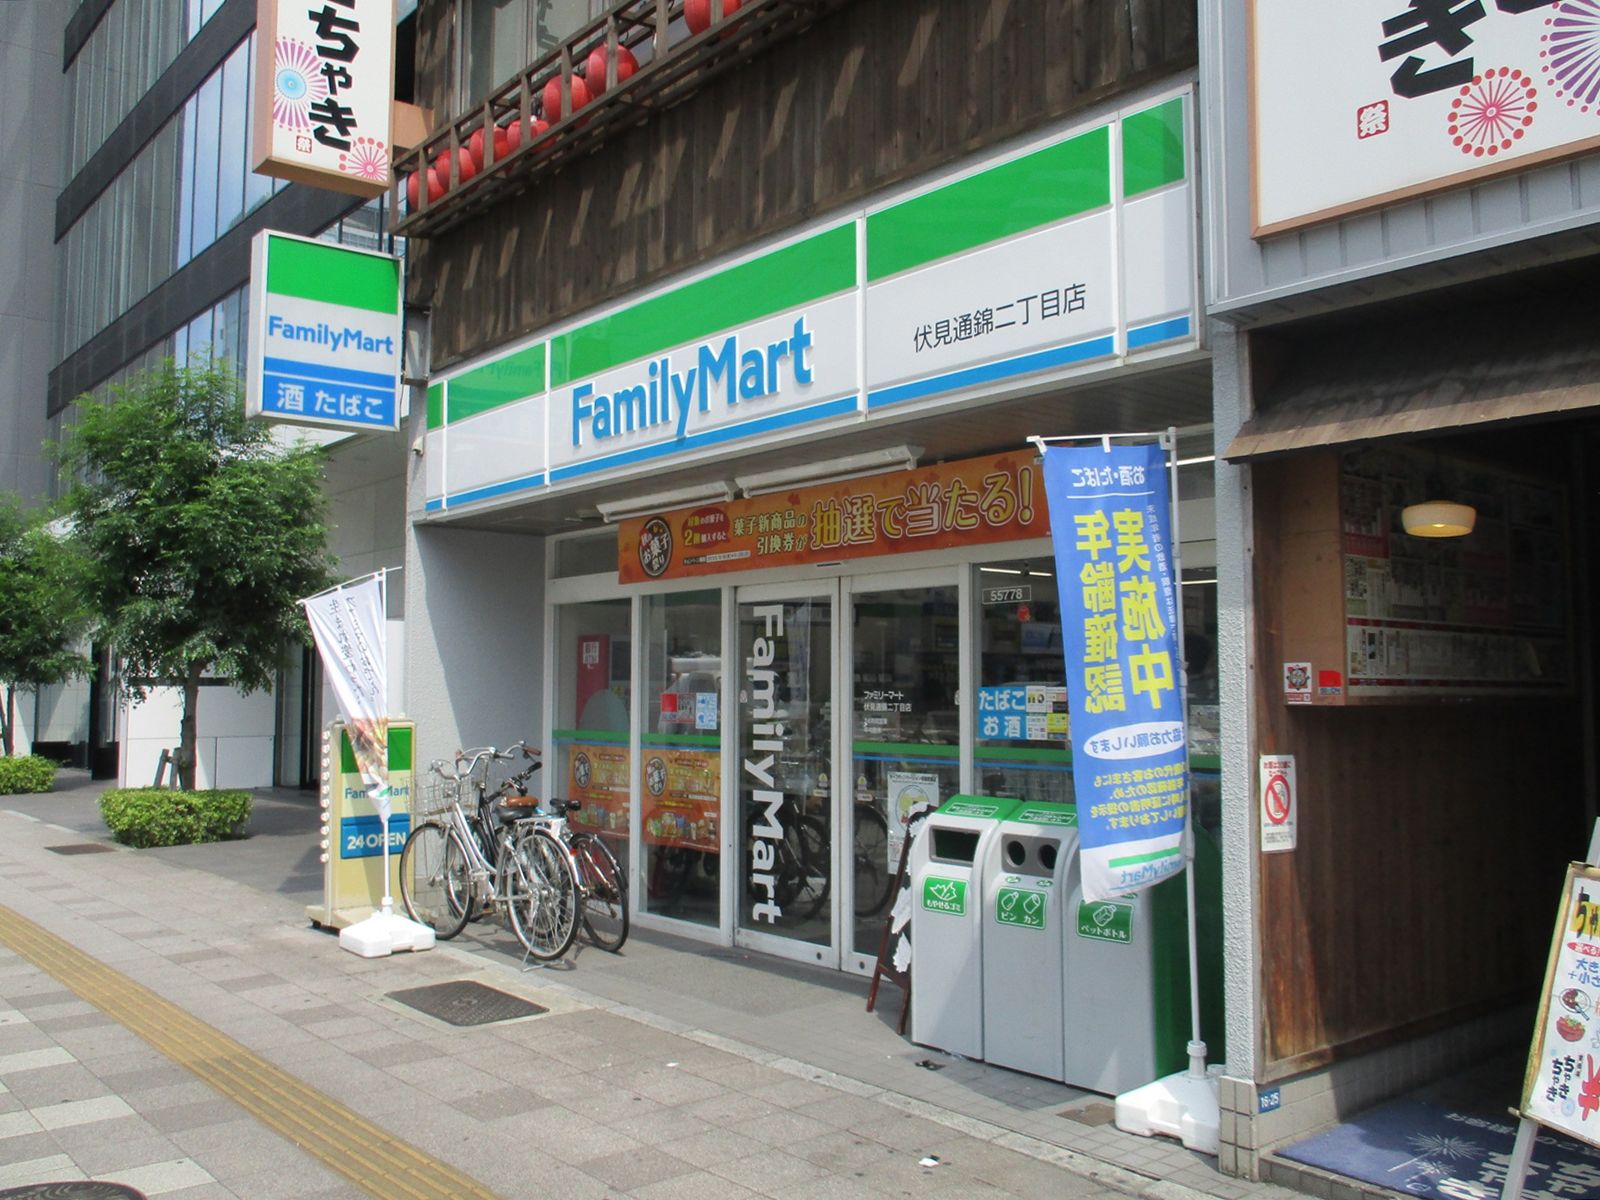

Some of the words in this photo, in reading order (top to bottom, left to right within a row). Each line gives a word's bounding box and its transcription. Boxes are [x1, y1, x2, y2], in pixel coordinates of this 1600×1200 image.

[1357, 100, 1390, 139] 祭
[913, 283, 1086, 353] 伏見通錦二丁目店
[268, 315, 393, 355] FamilyMart
[572, 314, 814, 447] FamilyMart
[277, 382, 304, 412] 酒
[315, 390, 383, 420] たばこ
[733, 510, 808, 537] 菓子新商品の
[811, 465, 1035, 550] 抽選で当たる!
[757, 535, 808, 555] 引換券が
[990, 589, 1023, 602] 55778
[864, 690, 904, 700] ファミリーマート
[979, 690, 1026, 711] たばこ
[983, 715, 1021, 738] お酒
[744, 604, 784, 925] FamilyMart
[347, 836, 364, 850] 24
[1024, 915, 1039, 924] カン
[1080, 925, 1127, 939] ペットボトル
[1546, 1058, 1563, 1103] ちゃき
[1559, 1055, 1575, 1100] ちゃき
